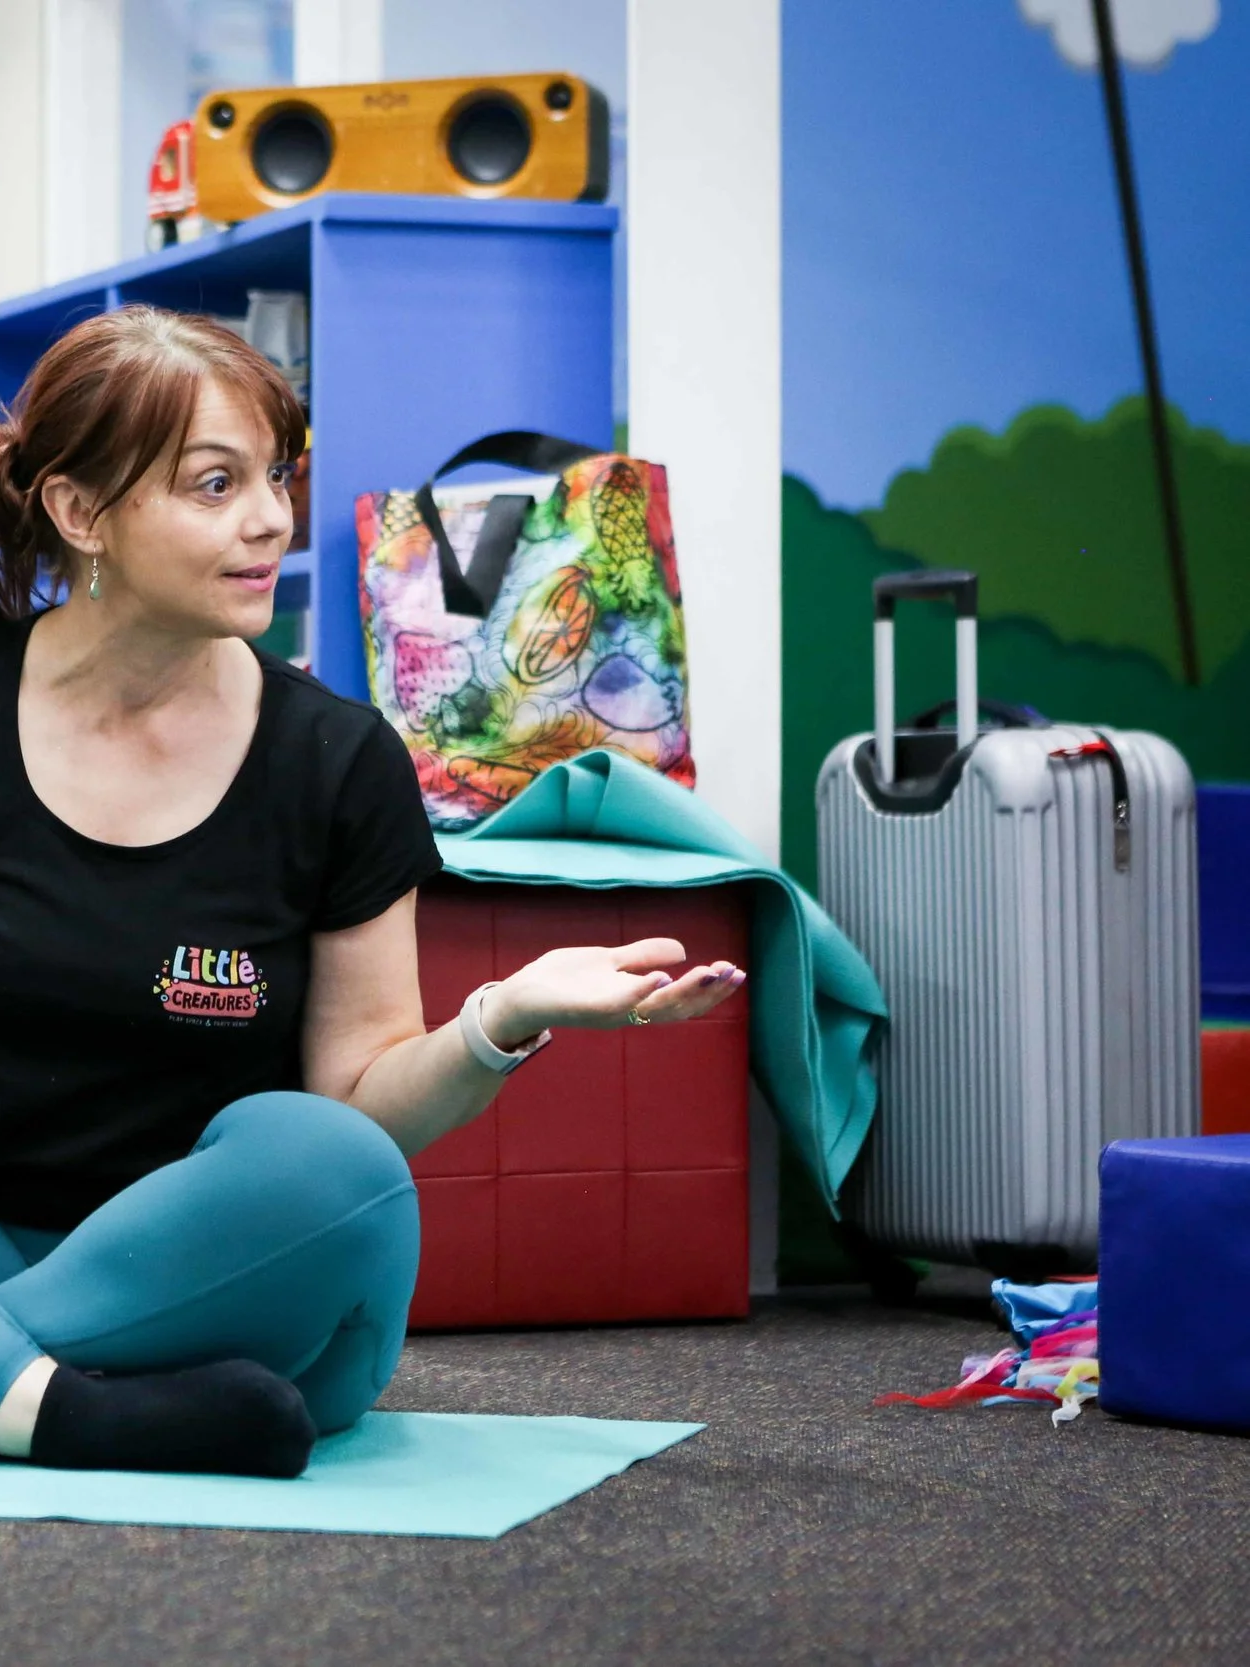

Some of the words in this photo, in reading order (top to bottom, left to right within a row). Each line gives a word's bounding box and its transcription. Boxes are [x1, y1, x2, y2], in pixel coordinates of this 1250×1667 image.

[172, 945, 256, 985] Little
[172, 990, 251, 1011] CREATURES
[205, 1019, 212, 1027] &
